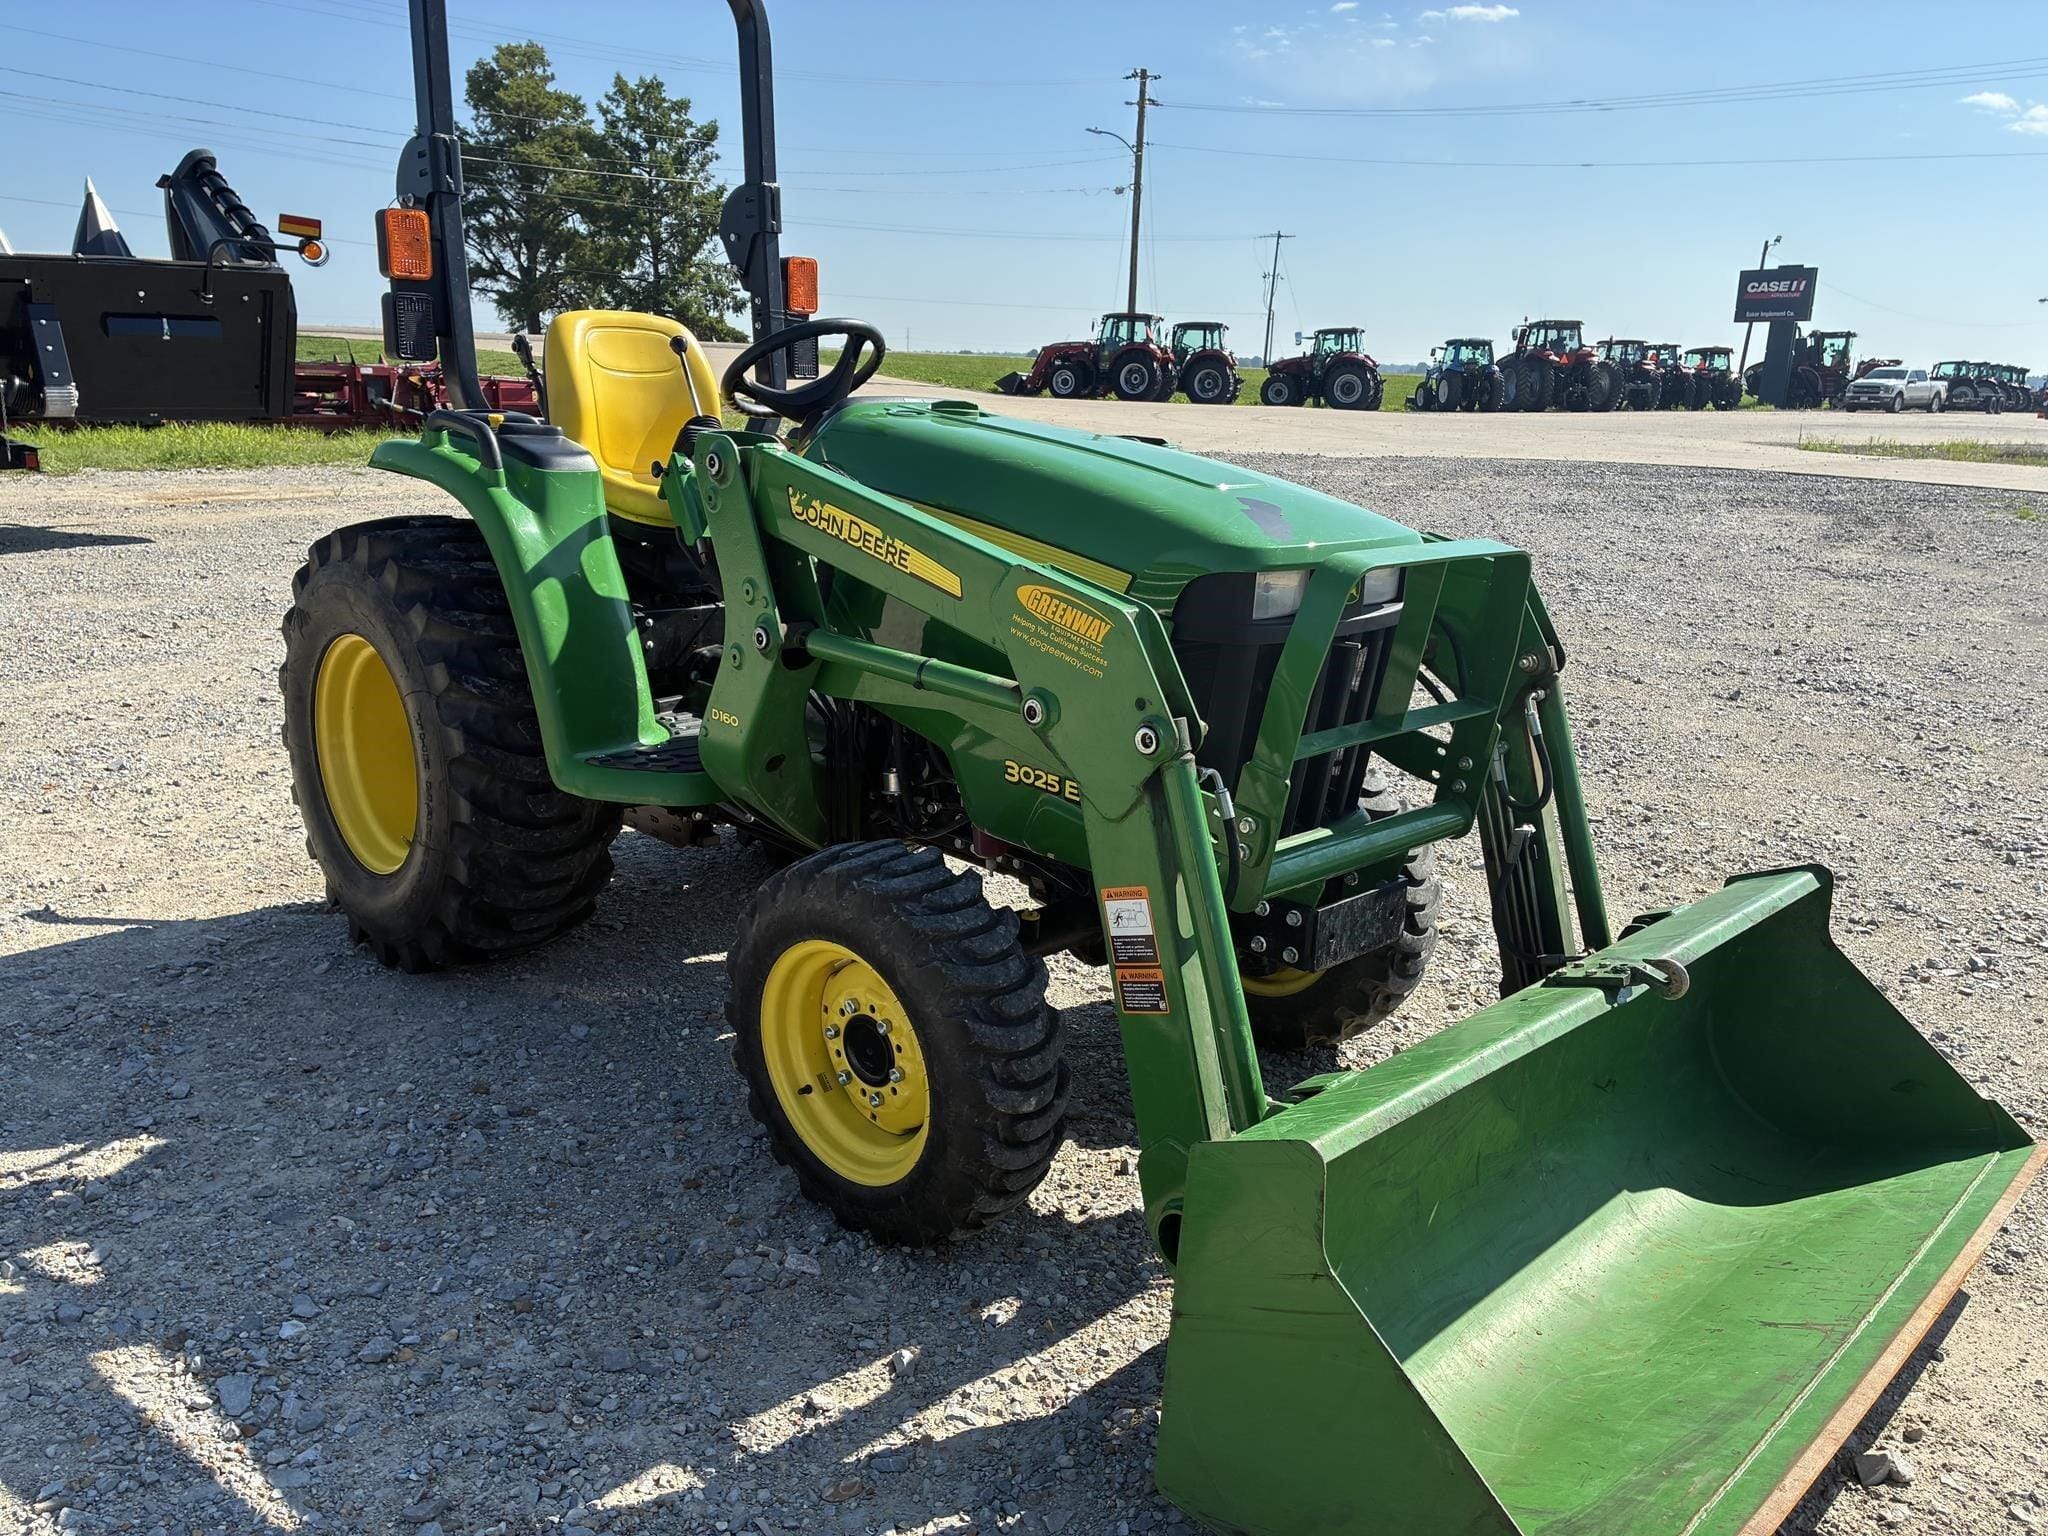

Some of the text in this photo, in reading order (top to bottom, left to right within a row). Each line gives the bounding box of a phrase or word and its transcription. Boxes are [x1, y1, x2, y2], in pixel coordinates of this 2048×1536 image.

[1746, 281, 1790, 293] CASE
[849, 519, 910, 569] DEERE
[1026, 588, 1112, 643] GREENWAY
[1010, 627, 1104, 678] www.gogreenway.com
[1012, 613, 1108, 667] Helping You Cultivate Success
[711, 708, 739, 727] D160
[1004, 759, 1081, 802] 3025 E
[1112, 890, 1143, 898] WARNING
[1128, 972, 1158, 980] WARNING
